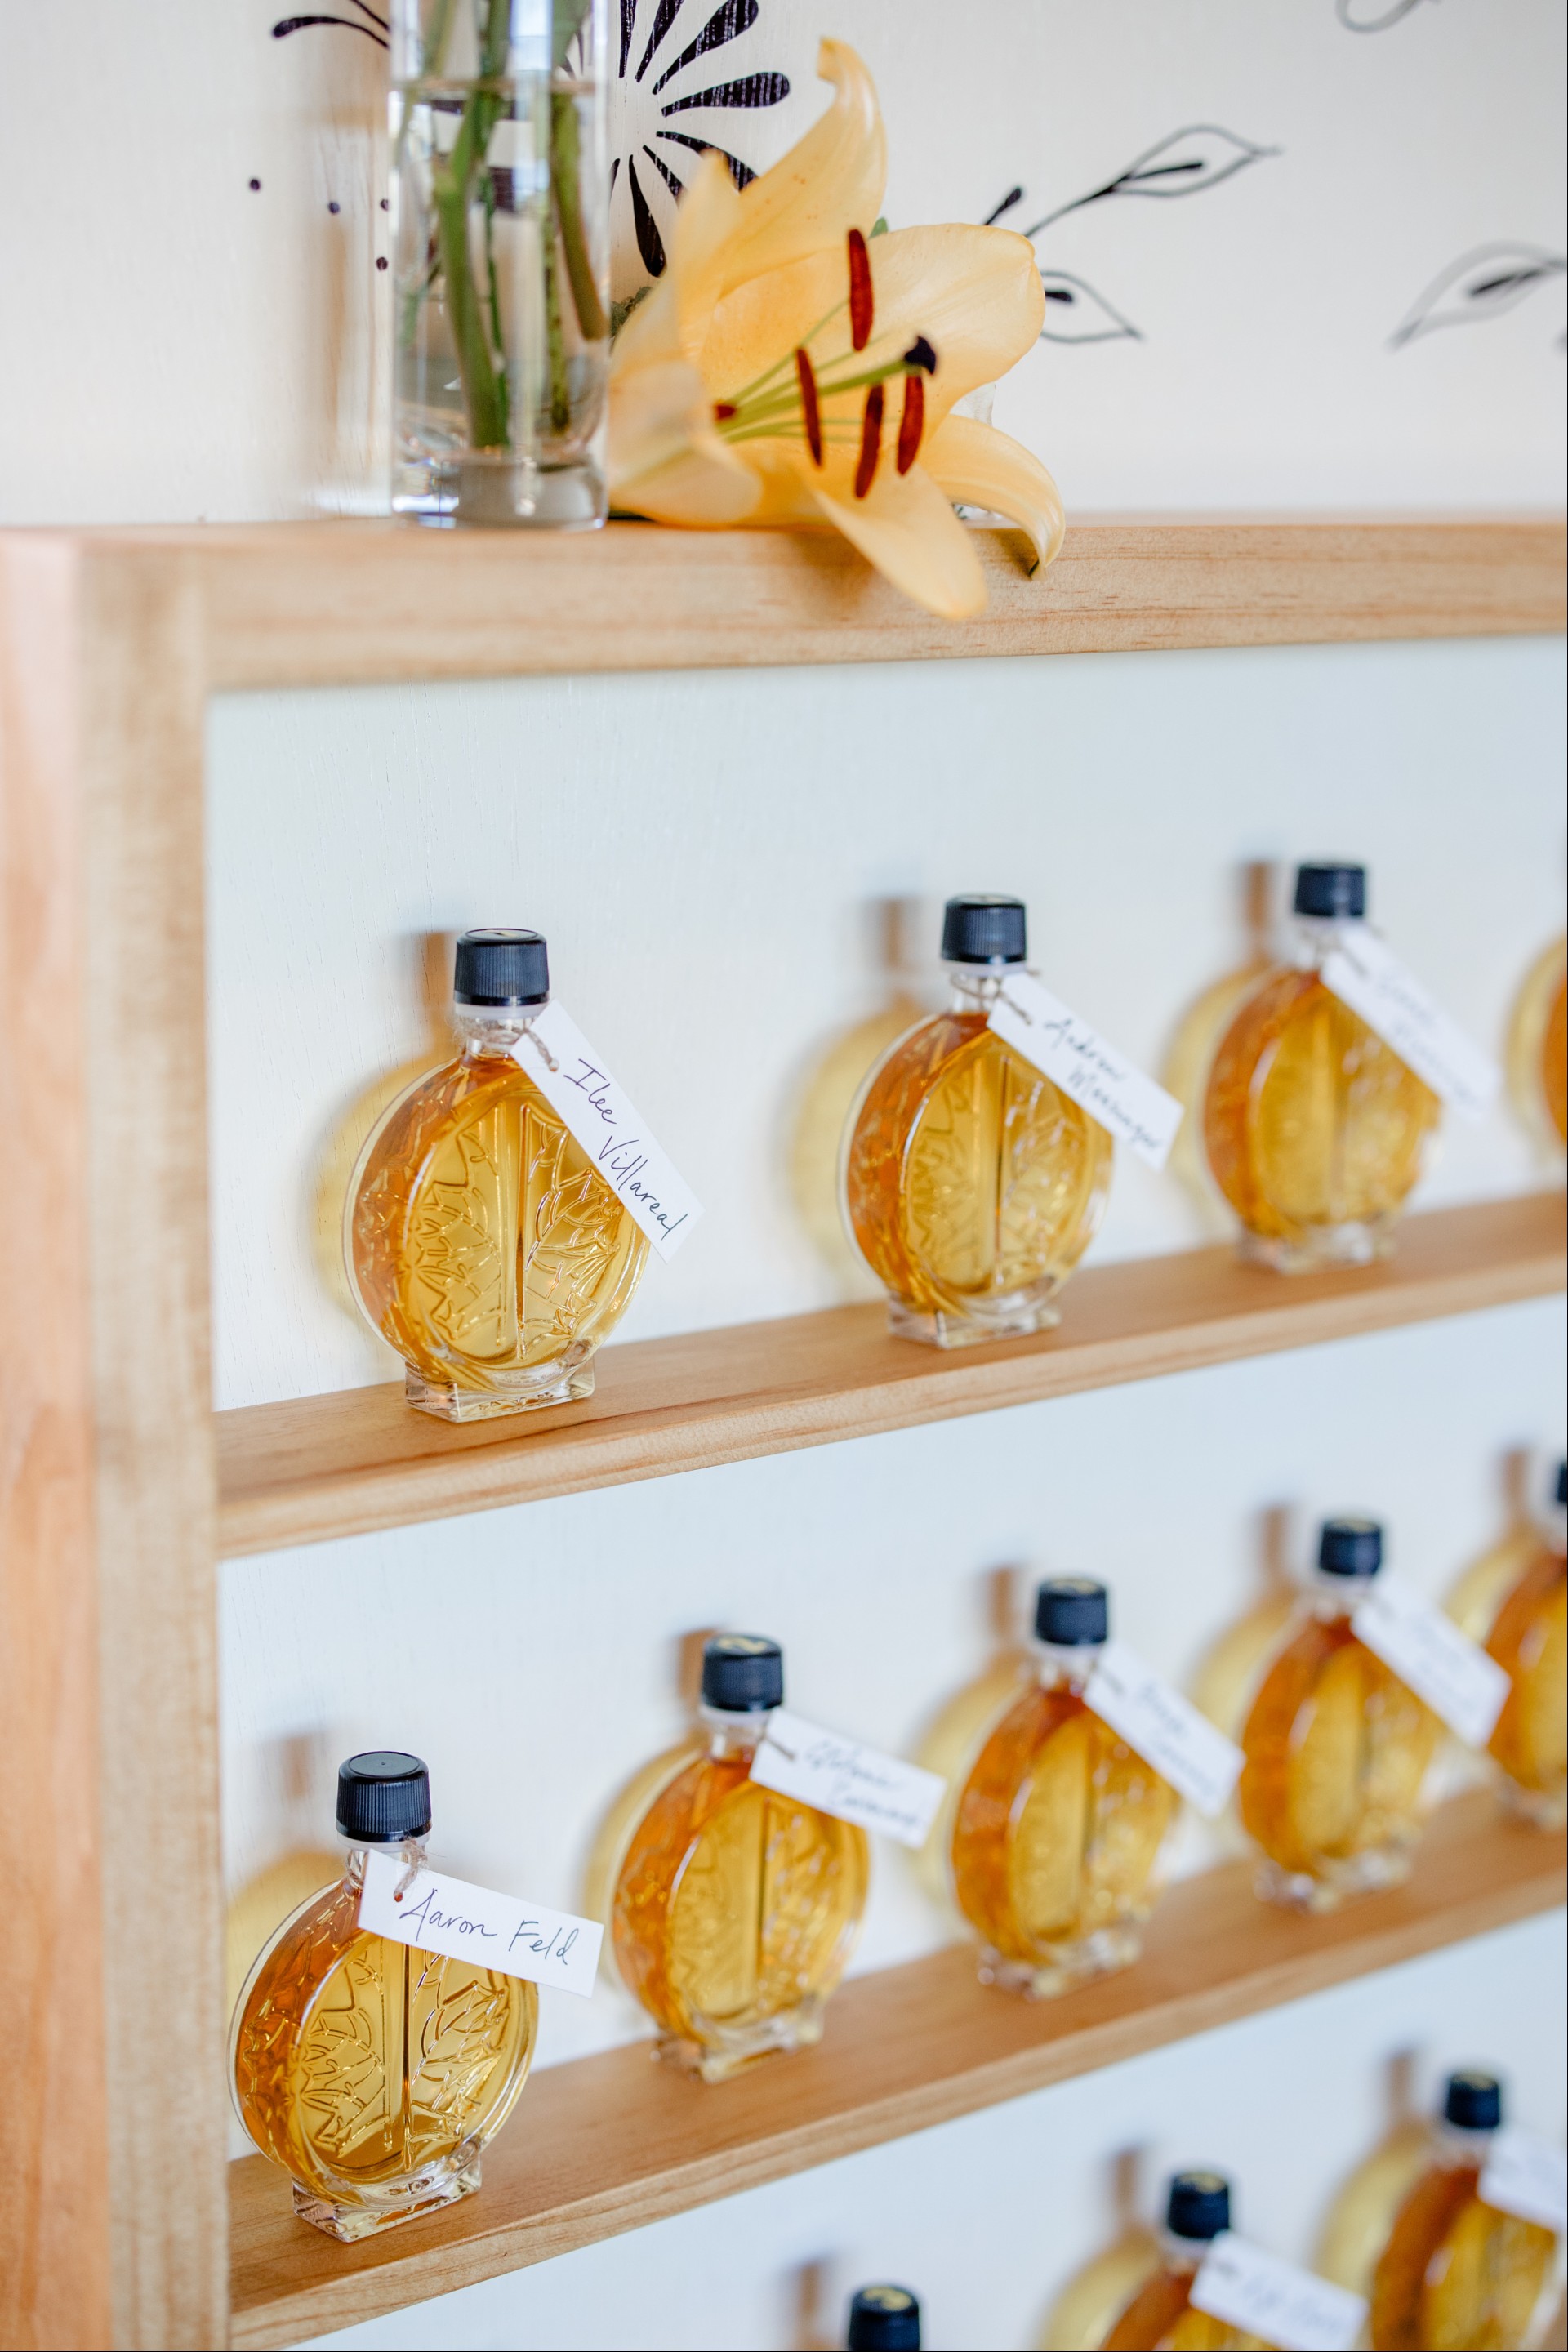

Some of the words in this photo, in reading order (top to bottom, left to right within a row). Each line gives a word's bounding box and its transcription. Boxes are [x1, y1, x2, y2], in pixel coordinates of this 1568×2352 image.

[599, 1135, 688, 1241] Villareal
[399, 1887, 498, 1942] Aaron
[508, 1920, 580, 1966] Feld
